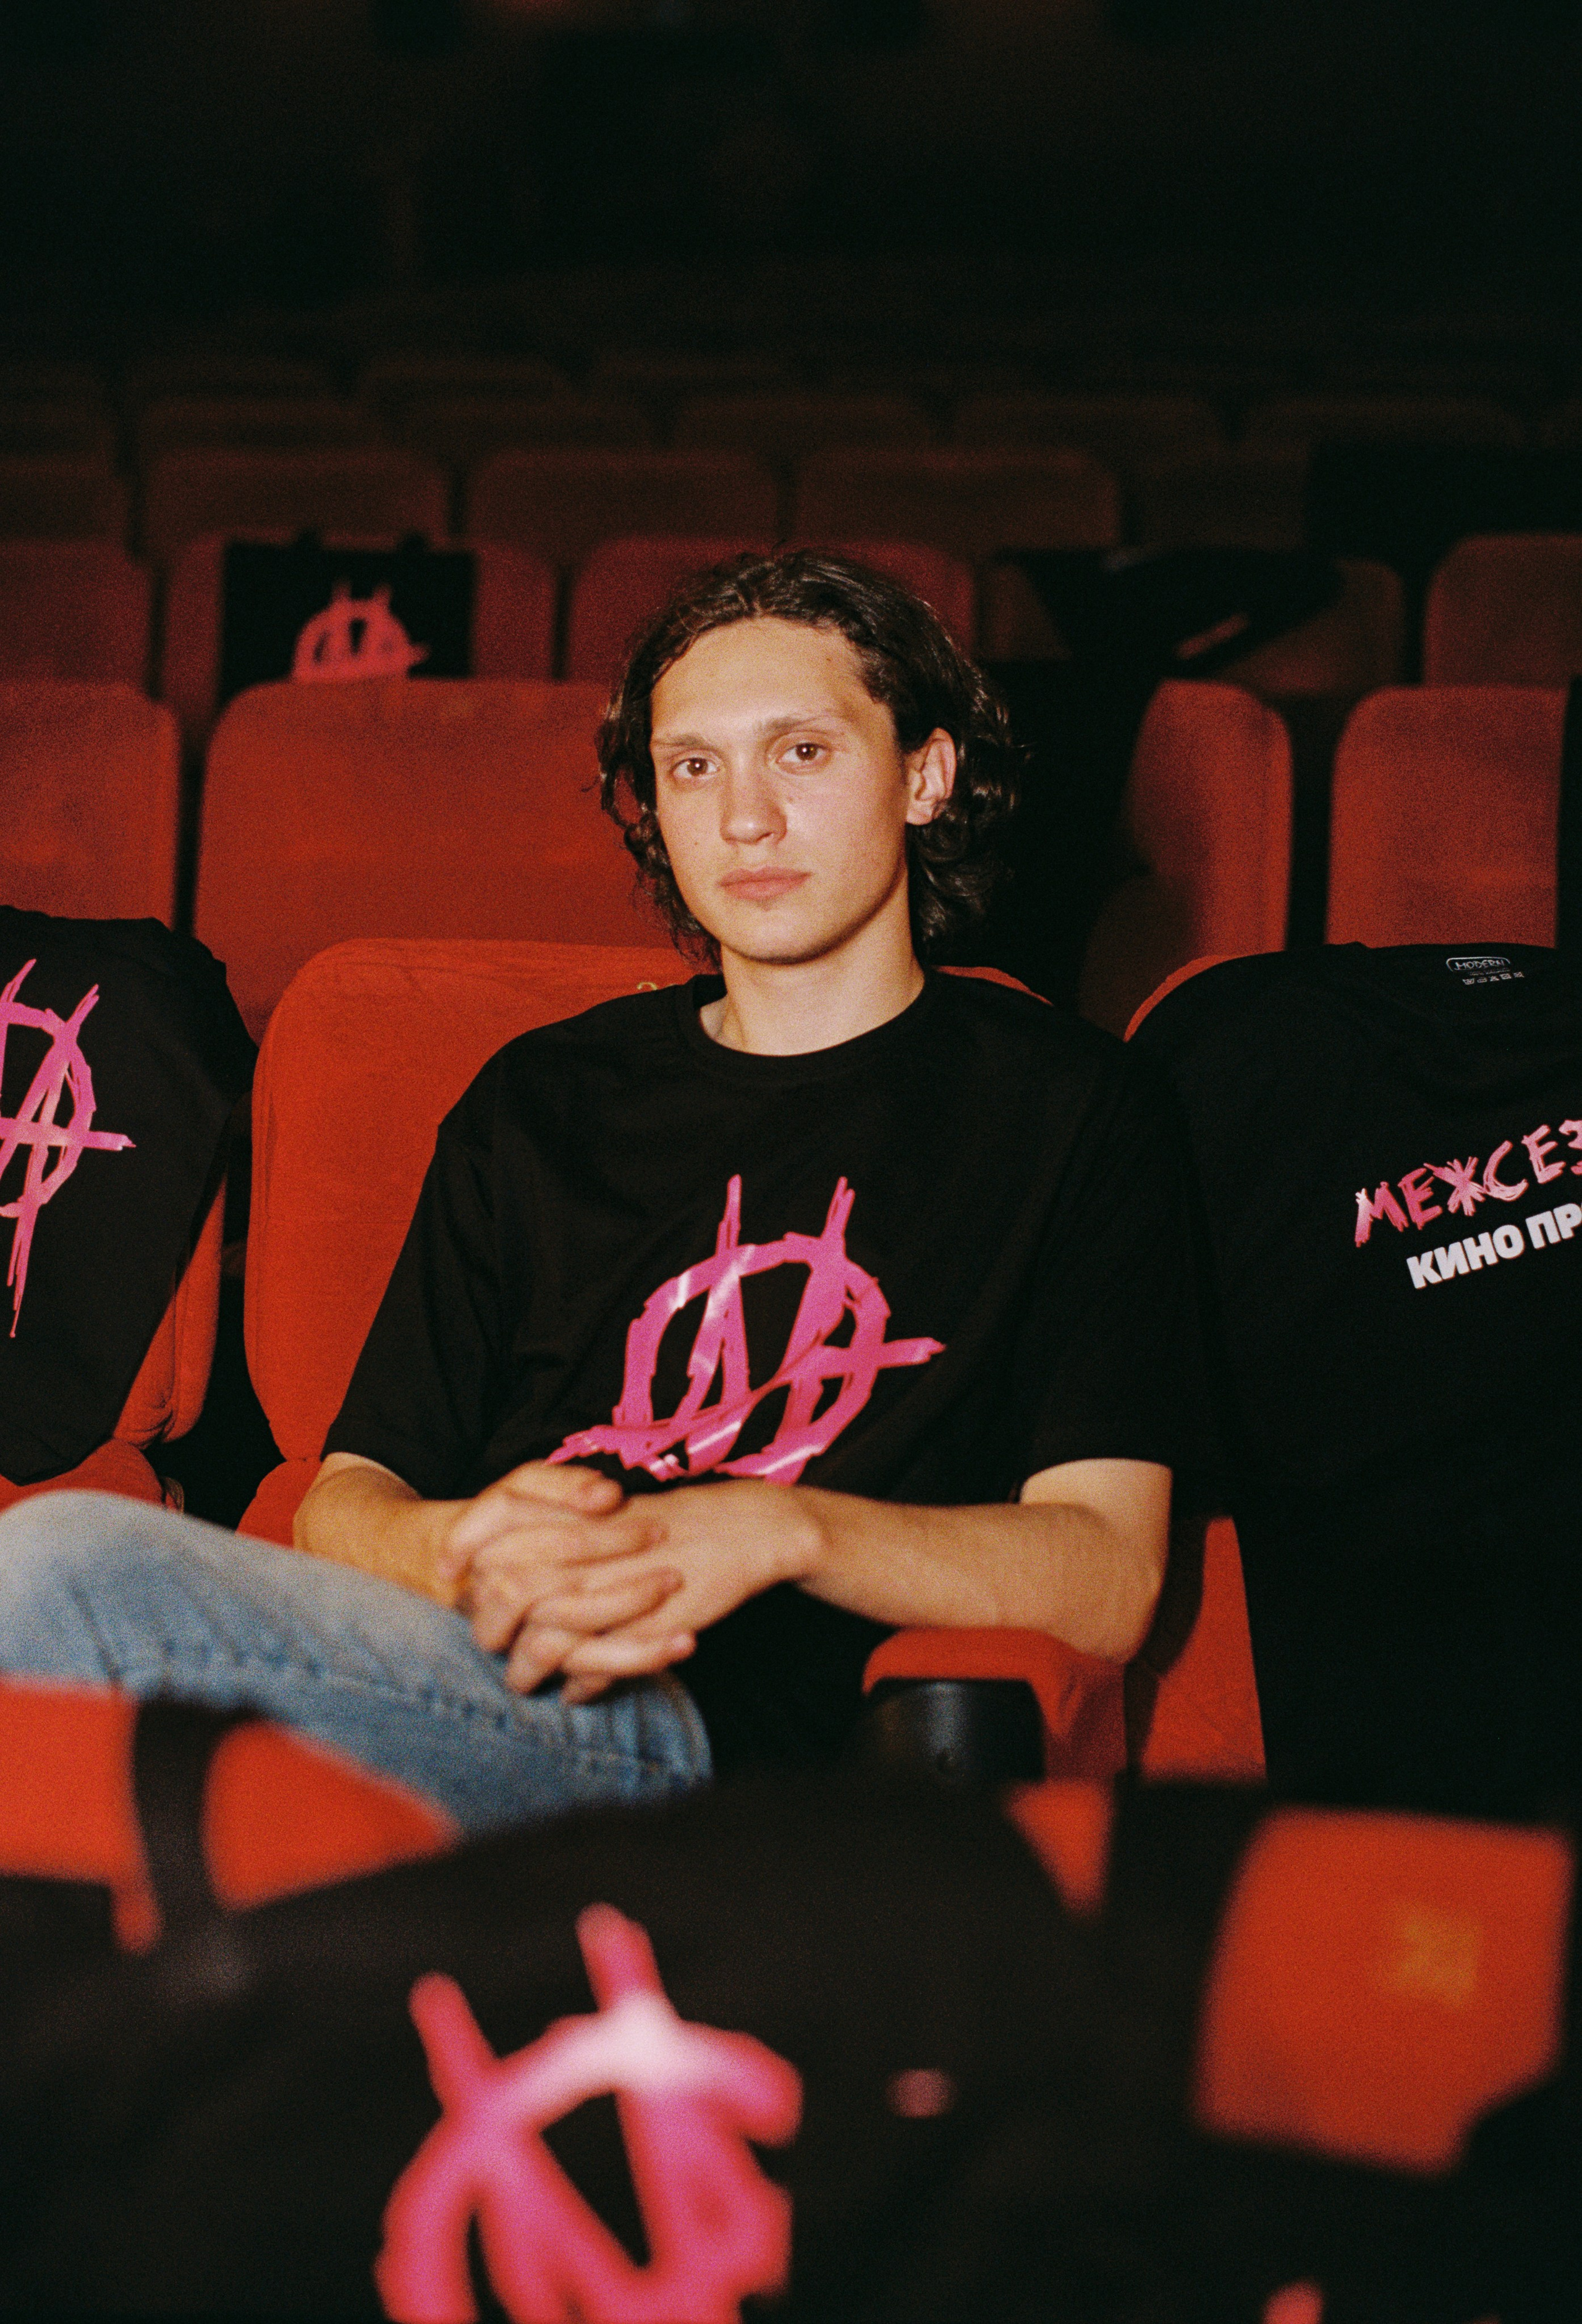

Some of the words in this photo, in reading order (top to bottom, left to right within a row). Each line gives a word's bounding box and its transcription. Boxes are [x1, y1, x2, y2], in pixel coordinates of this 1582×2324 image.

[1455, 960, 1505, 970] MODERN
[1406, 1224, 1525, 1290] КИНО
[1525, 1202, 1582, 1249] ПР
